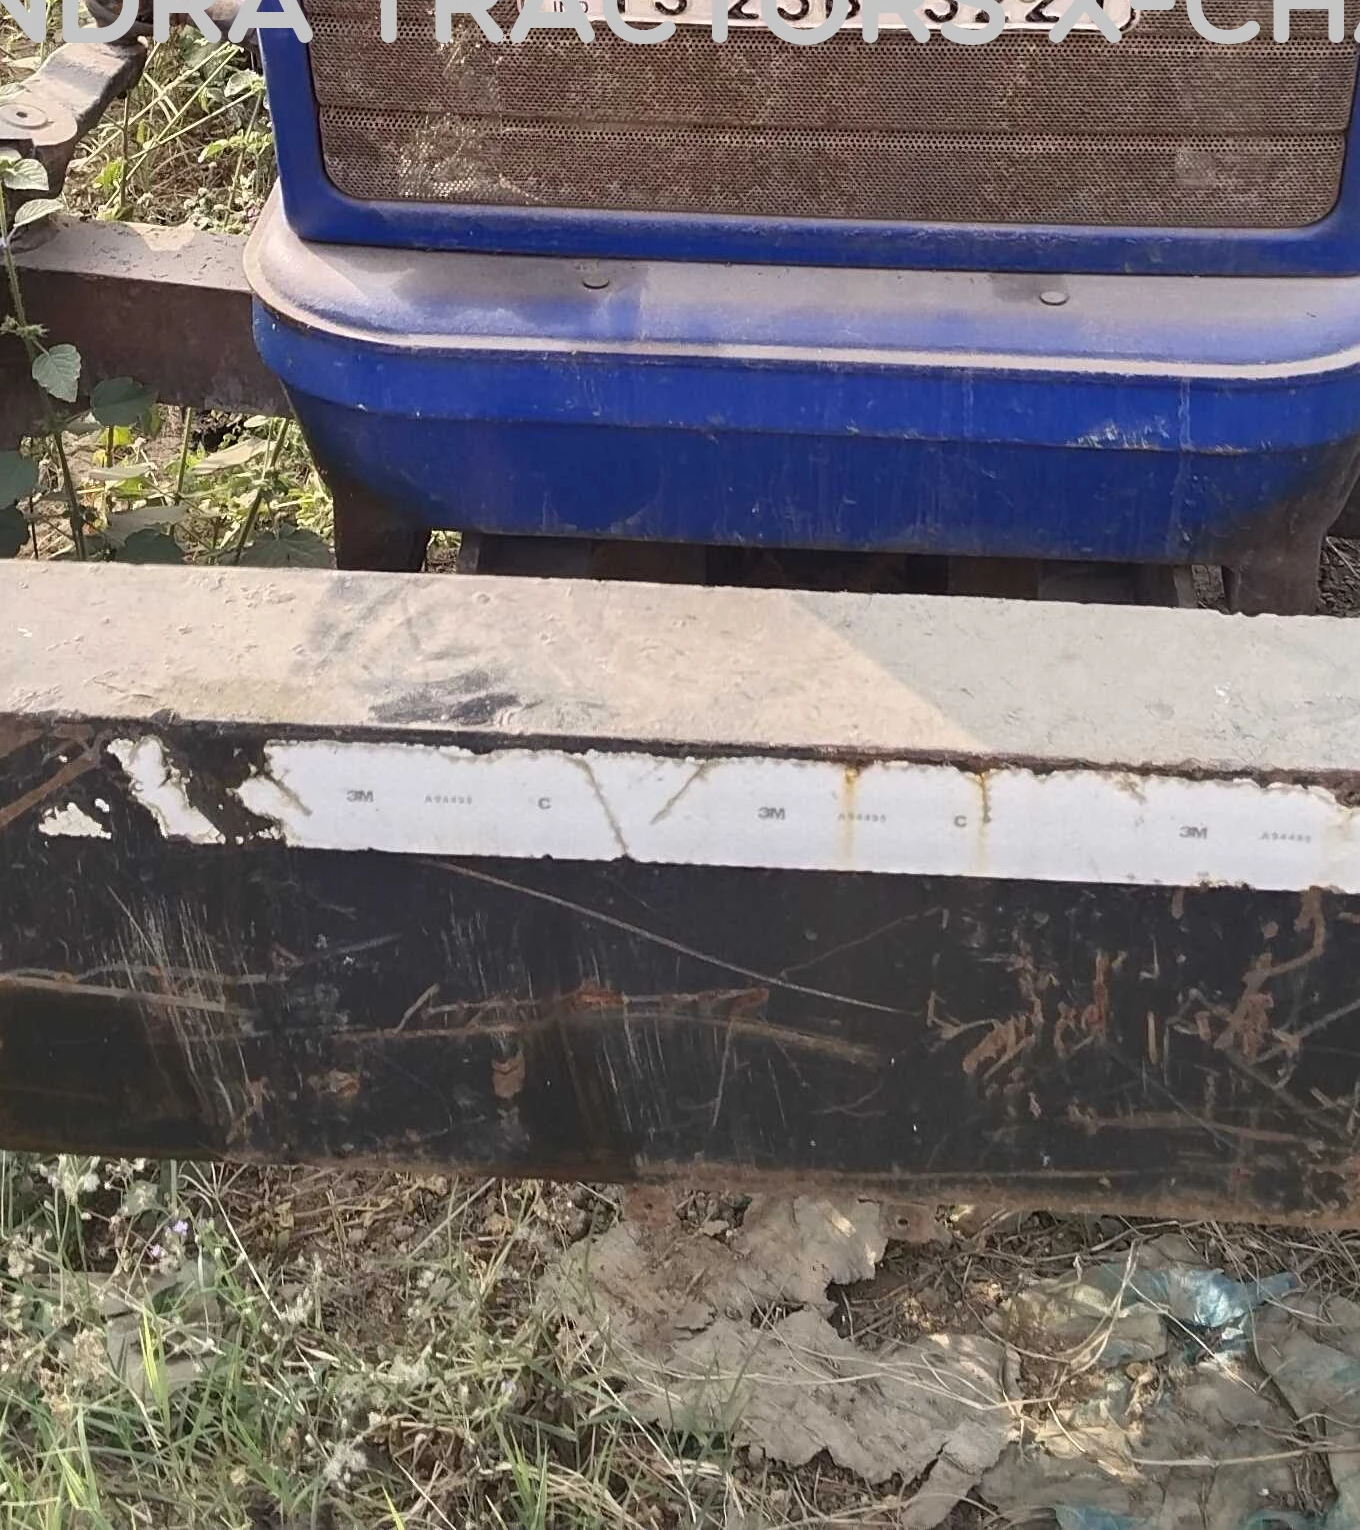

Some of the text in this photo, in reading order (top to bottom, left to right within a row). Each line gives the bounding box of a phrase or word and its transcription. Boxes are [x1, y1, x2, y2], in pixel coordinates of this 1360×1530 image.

[346, 789, 374, 803] 3M
[537, 796, 551, 810] C
[758, 806, 786, 820] 3M
[953, 814, 967, 828] C
[1179, 825, 1208, 839] 3M
